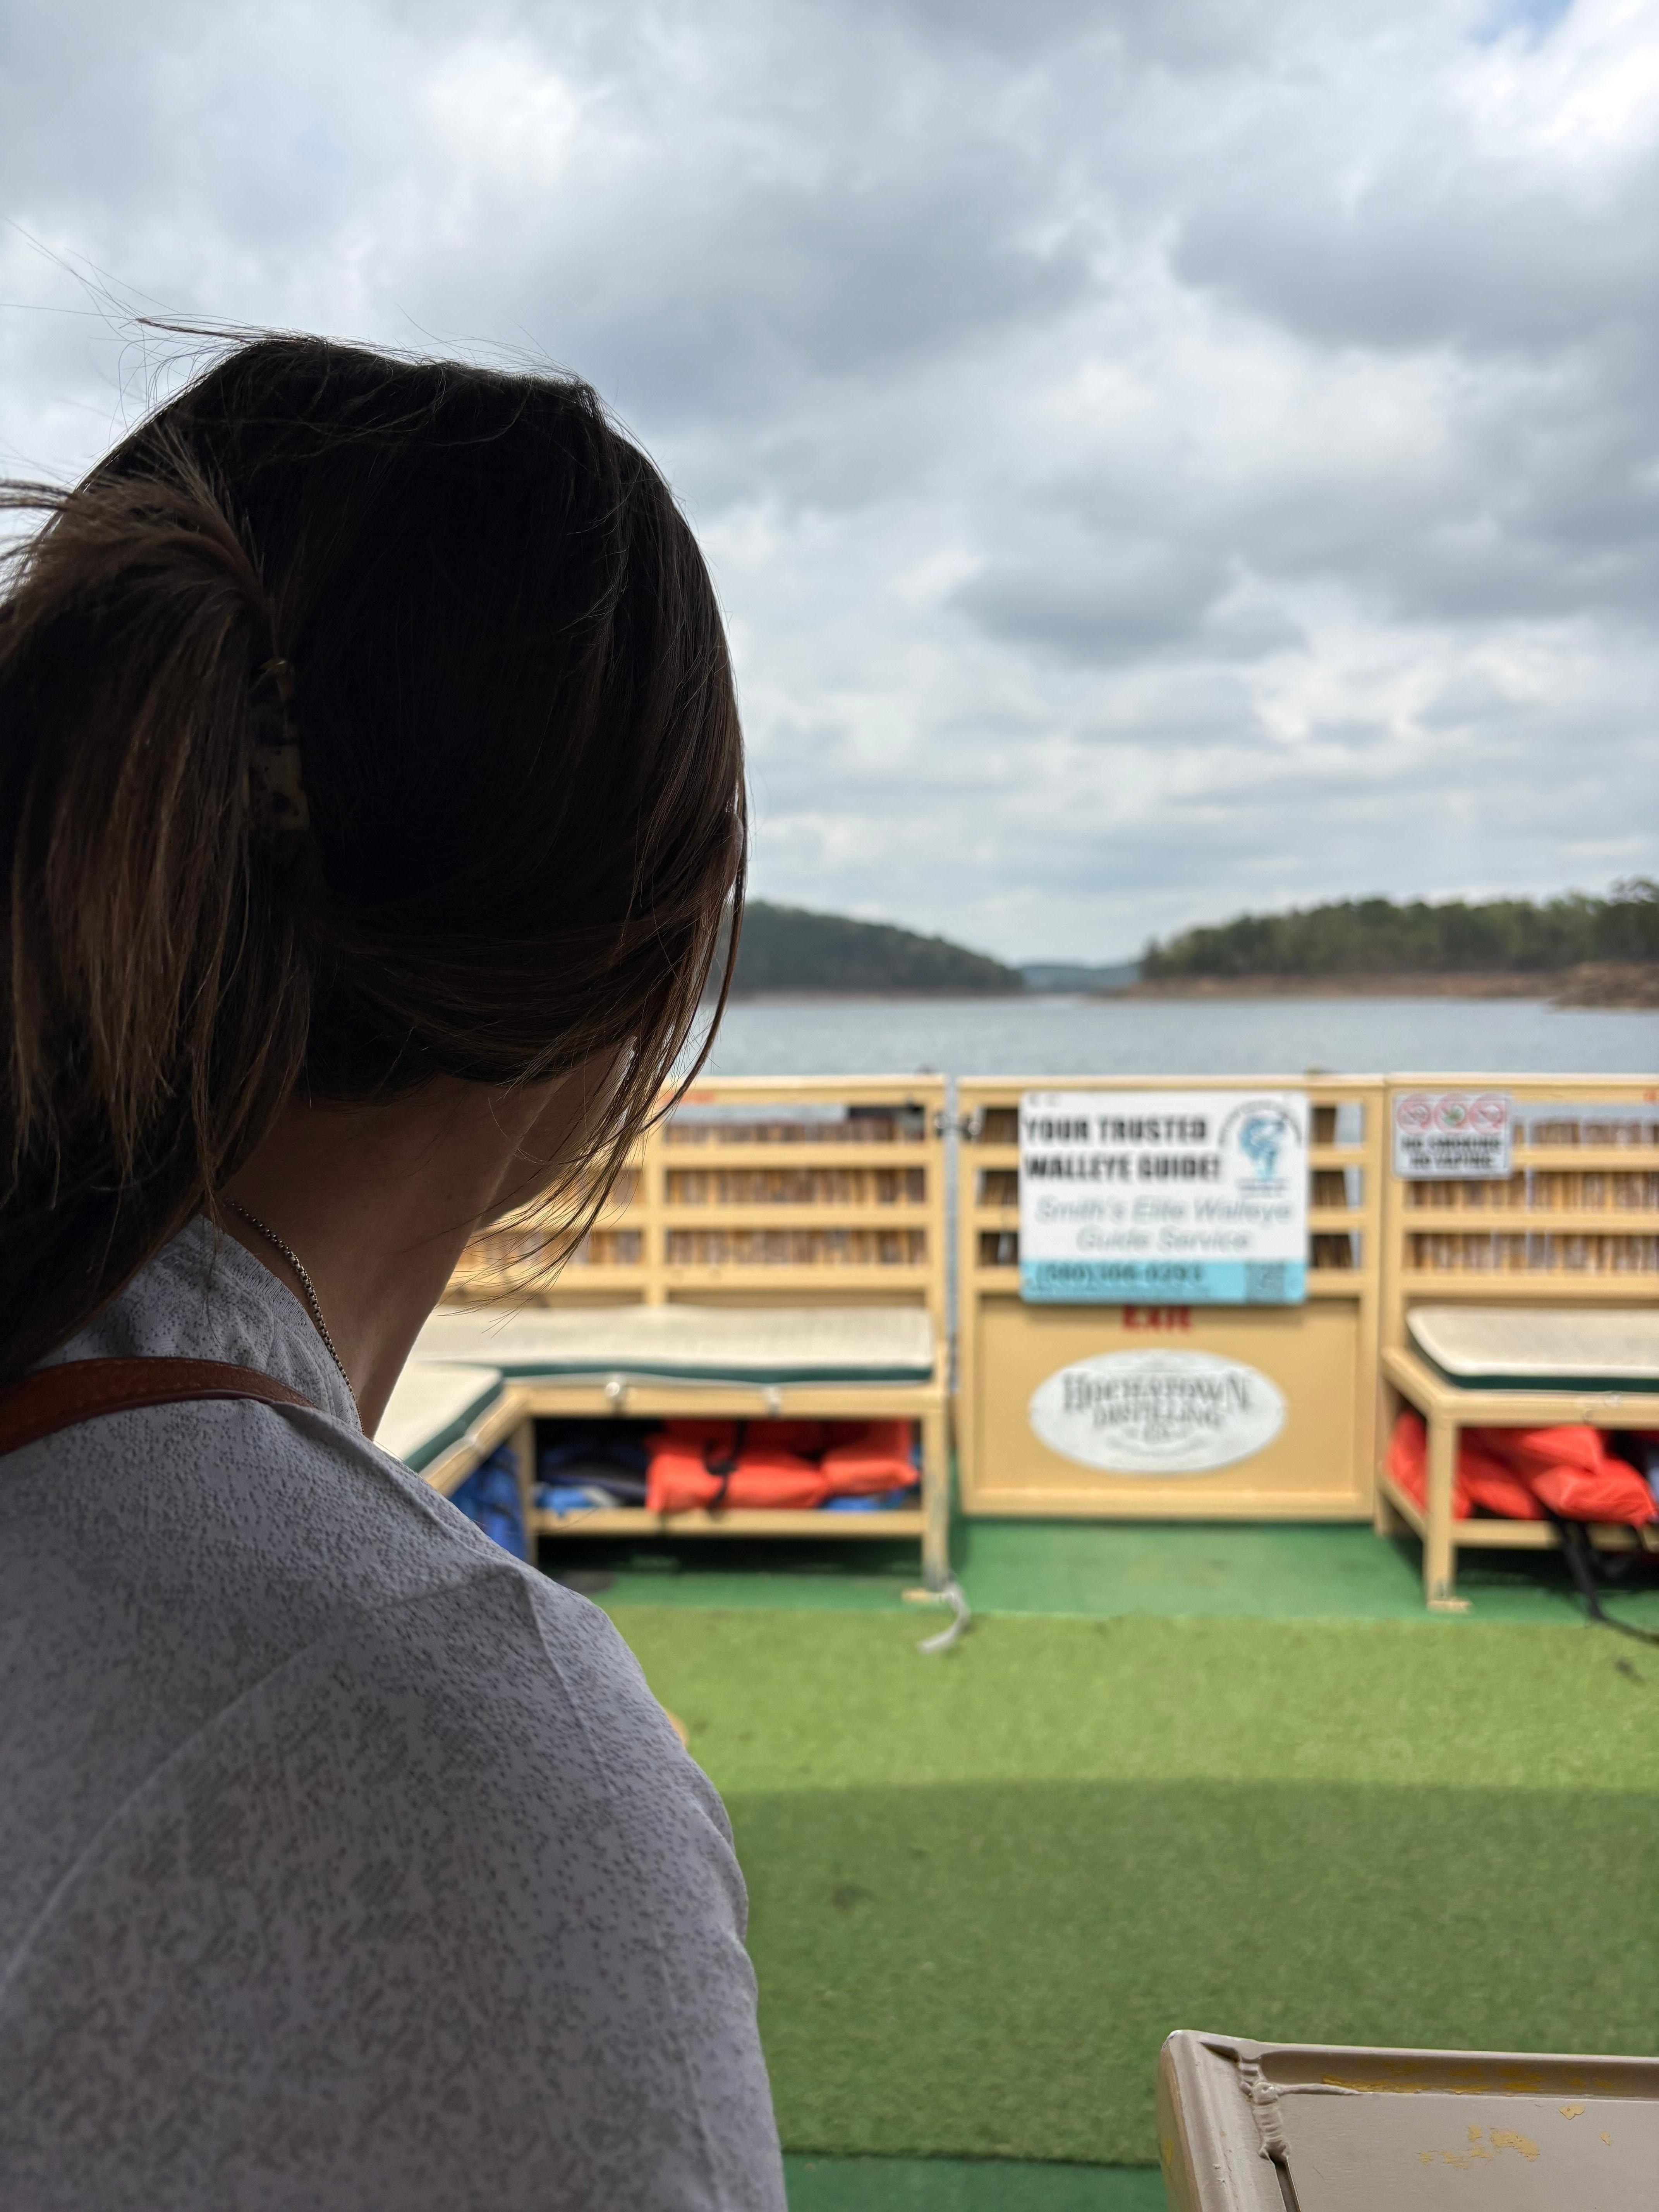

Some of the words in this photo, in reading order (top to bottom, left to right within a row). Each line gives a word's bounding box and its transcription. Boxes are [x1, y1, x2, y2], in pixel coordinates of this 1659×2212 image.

[1025, 1115, 1089, 1143] YOUR
[1097, 1115, 1208, 1143] TRUSTED
[1025, 1153, 1131, 1181] WALLEYE
[1136, 1153, 1221, 1181] GUIDE!
[1036, 1195, 1126, 1224] Smith's
[1194, 1197, 1293, 1229] Walleye
[1077, 1225, 1150, 1252] Guide
[1156, 1225, 1250, 1252] Service
